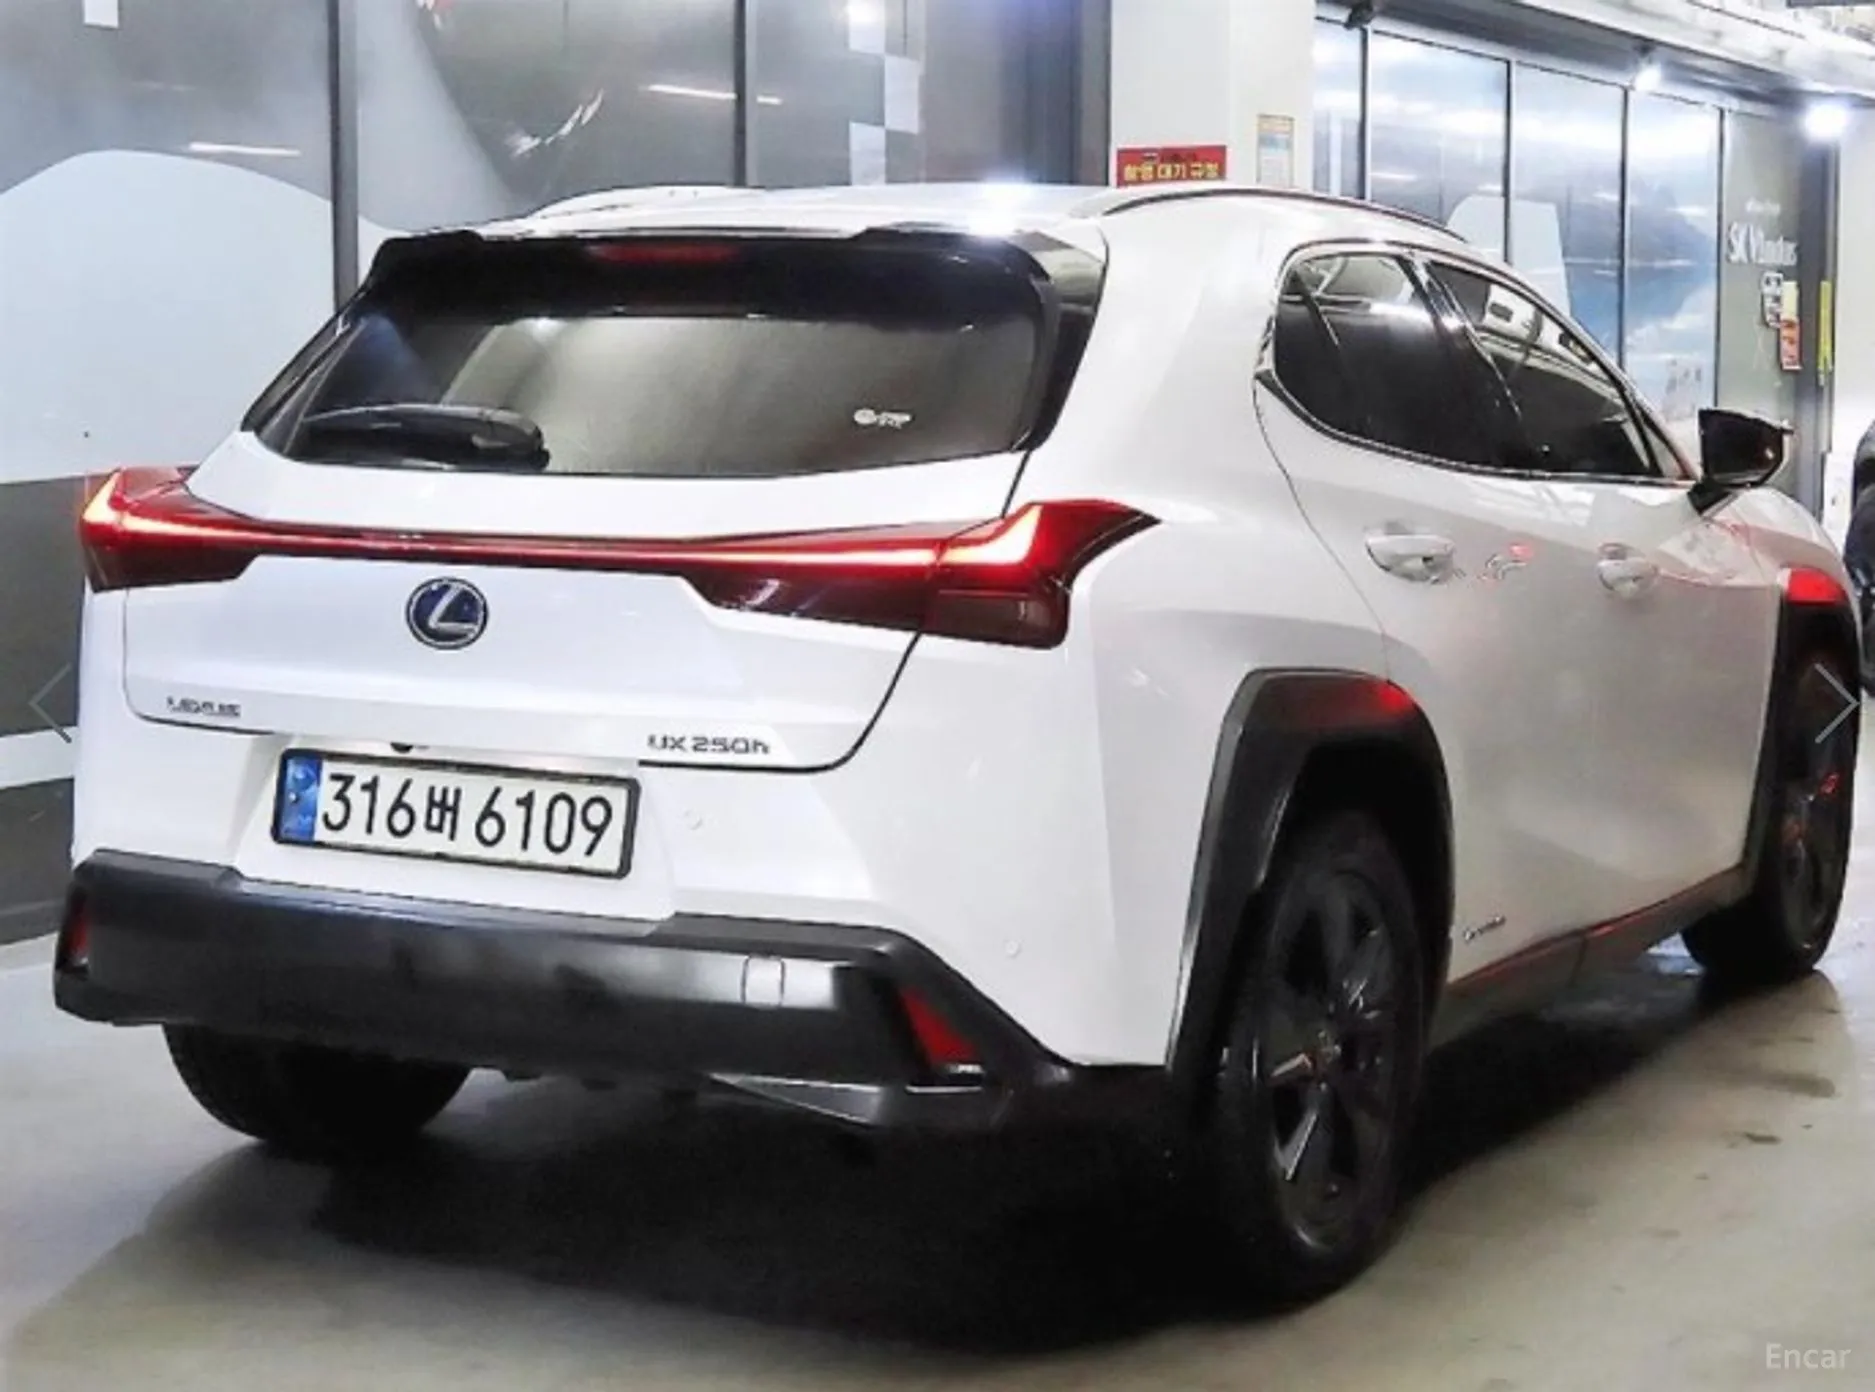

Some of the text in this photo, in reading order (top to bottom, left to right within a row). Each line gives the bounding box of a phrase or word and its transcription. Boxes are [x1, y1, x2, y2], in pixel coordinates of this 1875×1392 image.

[1157, 162, 1187, 180] 대기
[646, 734, 770, 755] UX 250h
[321, 772, 613, 857] 316버 6109
